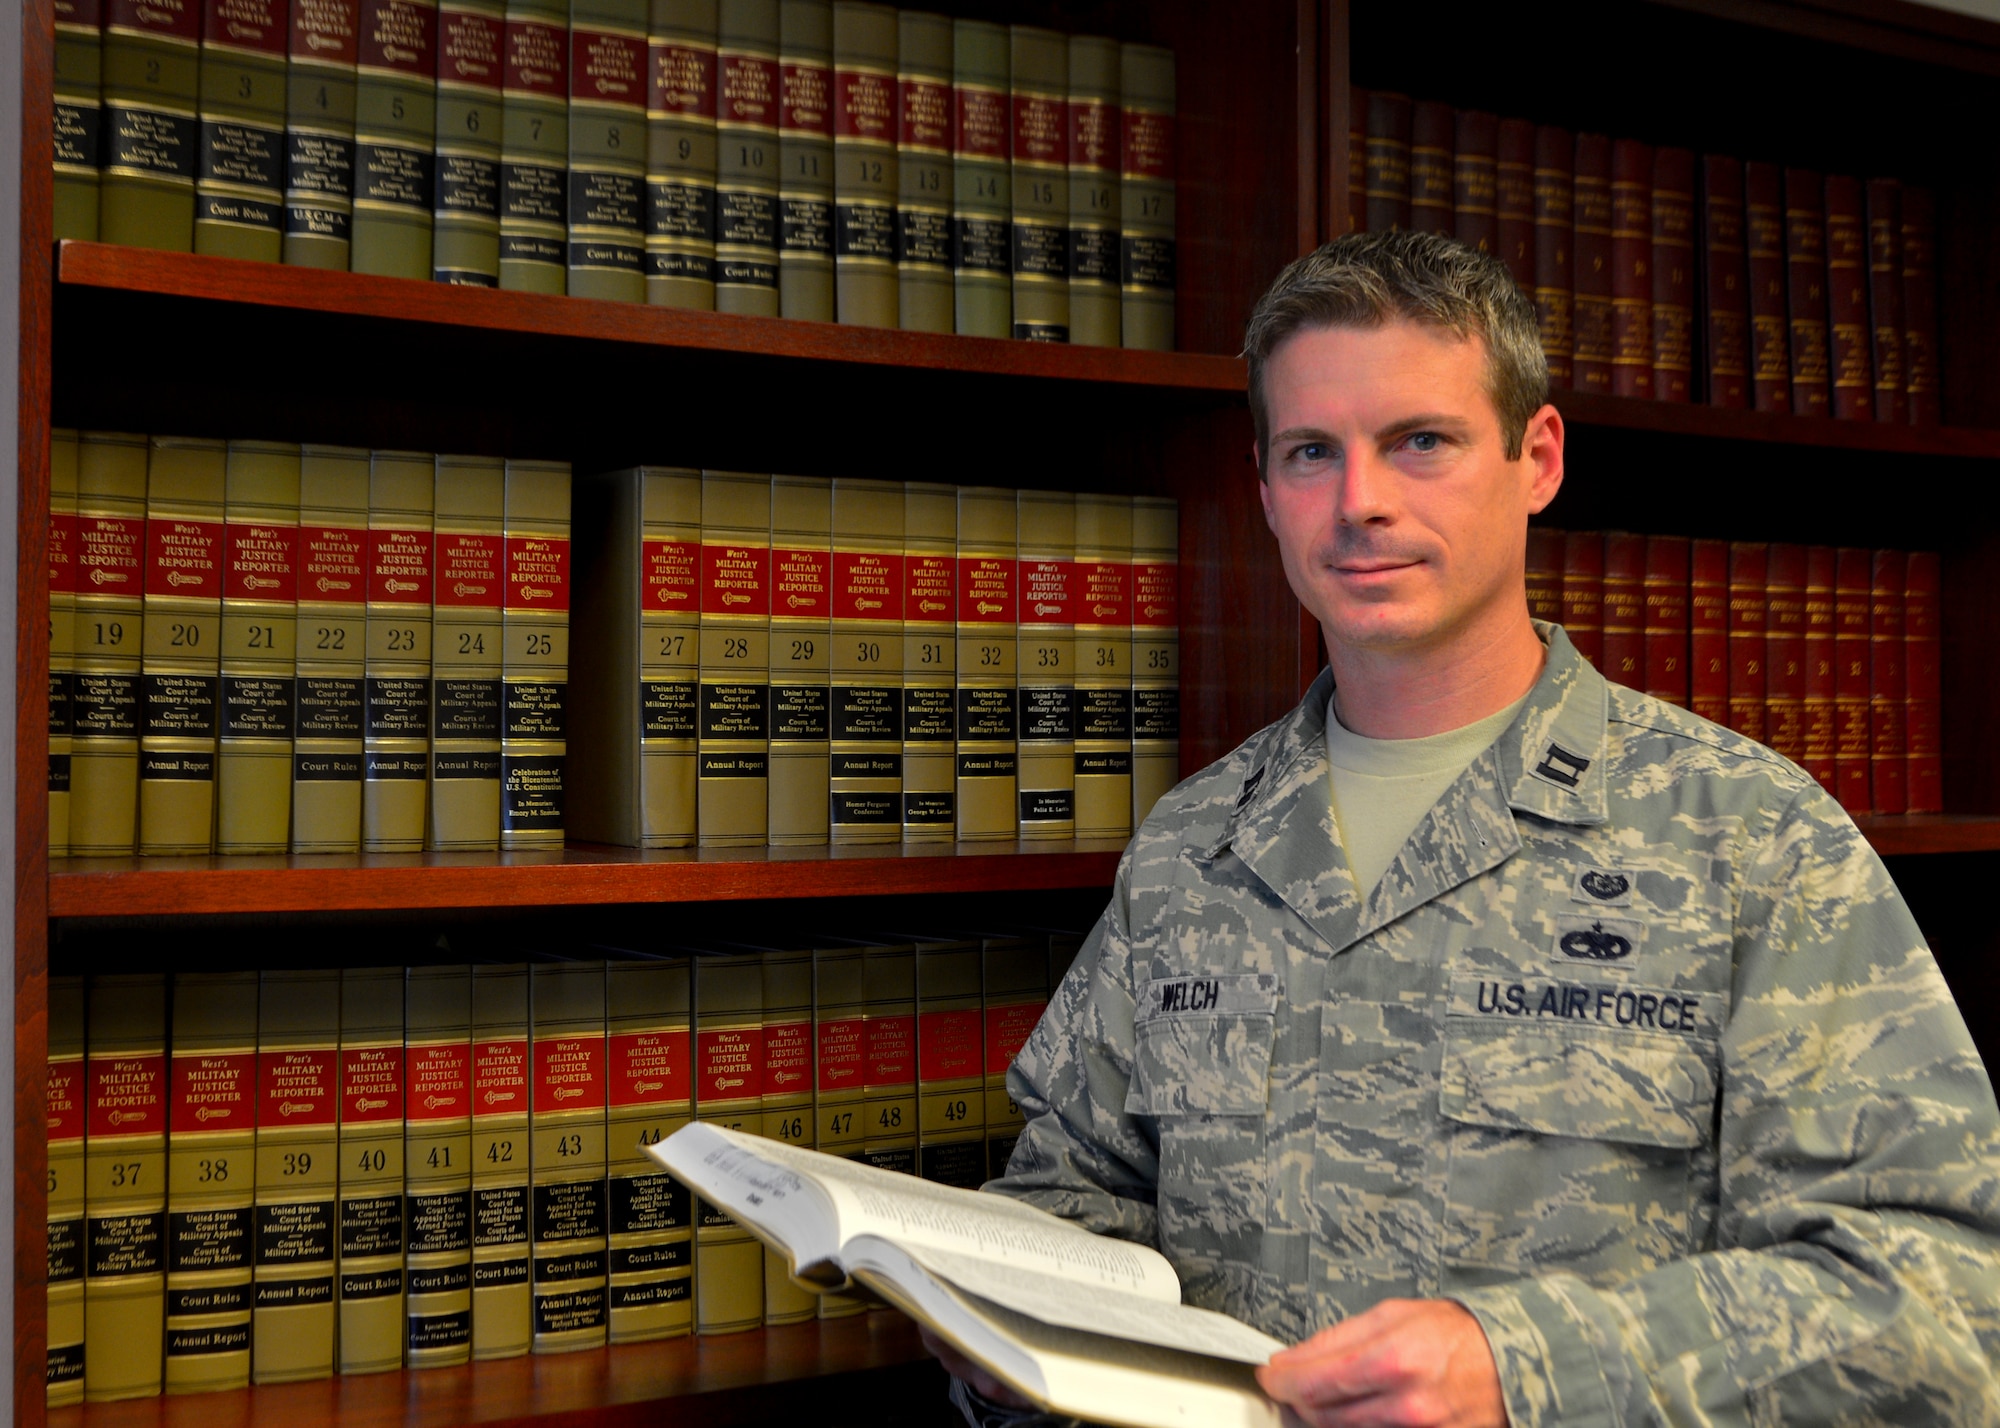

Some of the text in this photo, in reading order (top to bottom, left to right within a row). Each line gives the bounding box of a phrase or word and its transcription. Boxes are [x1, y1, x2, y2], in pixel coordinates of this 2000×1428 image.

[147, 59, 160, 83] 2
[240, 76, 251, 99] 3
[392, 96, 404, 121] 5
[467, 110, 480, 132] 6
[531, 119, 543, 140] 7
[607, 126, 620, 149] 8
[679, 138, 691, 160] 9
[741, 146, 763, 167] 10
[860, 160, 882, 183] 12
[920, 170, 939, 191] 13
[976, 176, 996, 198] 14
[211, 202, 269, 221] Court Rules
[587, 249, 638, 263] Court Rules
[656, 258, 707, 272] Court Rules
[725, 267, 774, 280] Court Rules
[174, 524, 201, 534] West's
[161, 535, 212, 547] MILITARY
[525, 542, 550, 551] West's
[165, 546, 207, 558] JUSTICE
[513, 552, 561, 562] MILITARY
[727, 550, 748, 559] West's
[158, 557, 213, 569] REPORTER
[518, 562, 557, 573] JUSTICE
[716, 559, 758, 569] MILITARY
[859, 557, 880, 566] West's
[1038, 564, 1058, 572] West's
[720, 569, 753, 579] JUSTICE
[849, 566, 889, 576] MILITARY
[1028, 573, 1067, 582] MILITARY
[511, 573, 562, 584] REPORTER
[714, 579, 759, 589] REPORTER
[853, 576, 885, 585] JUSTICE
[848, 586, 890, 595] REPORTER
[1032, 582, 1064, 591] JUSTICE
[1027, 592, 1067, 600] REPORTER
[94, 622, 123, 645] 19
[171, 624, 199, 646] 20
[248, 626, 274, 648] 21
[317, 628, 345, 650] 22
[388, 630, 414, 651] 23
[459, 633, 484, 654] 24
[526, 634, 551, 655] 25
[660, 636, 684, 656] 27
[724, 638, 748, 658] 28
[791, 640, 814, 660] 29
[857, 642, 880, 662] 30
[922, 644, 942, 664] 31
[981, 646, 1001, 666] 32
[1038, 648, 1059, 666] 33
[1096, 647, 1116, 667] 34
[1148, 650, 1169, 668] 35
[710, 702, 761, 711] Military Appeals
[711, 724, 759, 733] Military Review
[147, 761, 210, 772] Annual Report
[302, 762, 357, 771] Court Rules
[437, 761, 469, 769] Annual
[706, 760, 763, 770] Annual Report
[844, 761, 893, 770] Annual Report
[964, 760, 1014, 770] Annual Report
[1083, 759, 1127, 768] Annual Report
[1162, 981, 1218, 1012] WELCH
[1478, 982, 1699, 1031] U.S. AIR FORCE
[719, 1034, 741, 1043] West's
[488, 1045, 512, 1055] West's
[708, 1043, 750, 1054] MILITARY
[360, 1052, 385, 1061] West's
[477, 1055, 522, 1066] MILITARY
[711, 1054, 748, 1064] JUSTICE
[202, 1059, 228, 1069] West's
[348, 1061, 396, 1072] MILITARY
[481, 1066, 519, 1076] JUSTICE
[707, 1063, 752, 1075] REPORTER
[188, 1069, 240, 1081] MILITARY
[352, 1072, 392, 1083] JUSTICE
[476, 1076, 524, 1088] REPORTER
[193, 1081, 236, 1092] JUSTICE
[346, 1083, 397, 1095] REPORTER
[186, 1092, 241, 1104] REPORTER
[879, 1107, 901, 1128] 48
[945, 1101, 966, 1122] 49
[780, 1118, 802, 1138] 46
[831, 1113, 853, 1134] 47
[639, 1128, 660, 1146] 44
[487, 1141, 512, 1162] 42
[557, 1134, 582, 1156] 43
[283, 1152, 312, 1176] 39
[358, 1149, 386, 1172] 40
[427, 1147, 452, 1168] 41
[112, 1162, 141, 1187] 37
[198, 1158, 228, 1182] 38
[271, 1205, 320, 1216] United States
[280, 1214, 311, 1224] Court of
[628, 1250, 677, 1264] Court Rules
[476, 1265, 527, 1279] Court Rules
[547, 1259, 598, 1274] Court Rules
[258, 1284, 329, 1300] Annual Report
[345, 1277, 400, 1293] Court Rules
[181, 1293, 240, 1307] Court Rules
[623, 1285, 683, 1302] Annual Report
[173, 1331, 246, 1348] Annual Report
